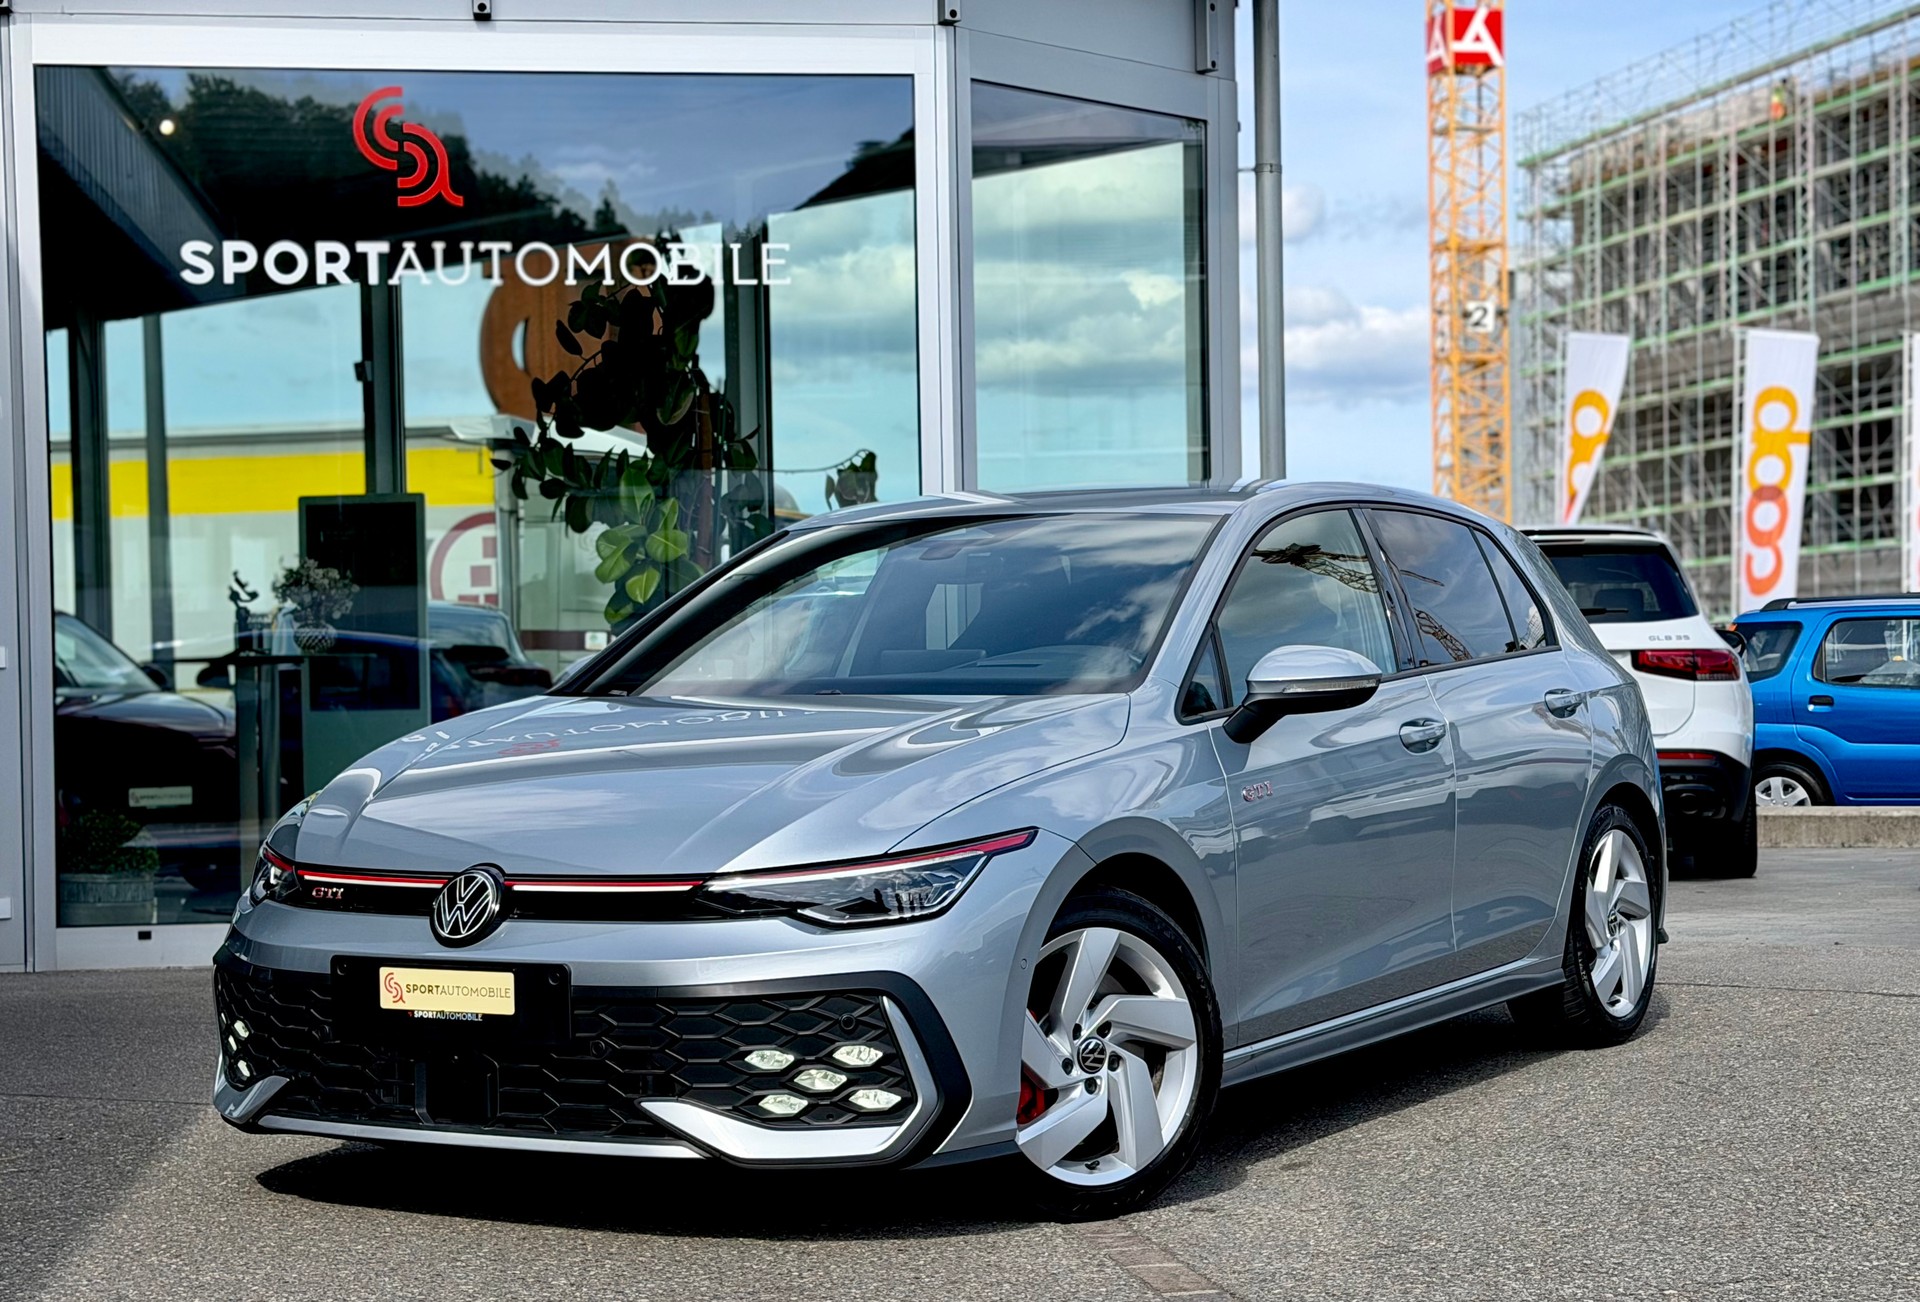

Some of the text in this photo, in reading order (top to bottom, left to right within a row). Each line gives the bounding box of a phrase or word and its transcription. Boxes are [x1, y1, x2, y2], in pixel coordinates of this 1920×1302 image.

[179, 239, 792, 286] SPORTAUTOMOBILE
[1470, 305, 1488, 327] 2
[1242, 781, 1273, 802] GTI
[312, 887, 345, 899] GTI
[405, 983, 511, 999] SPORTAUTOMOBILE
